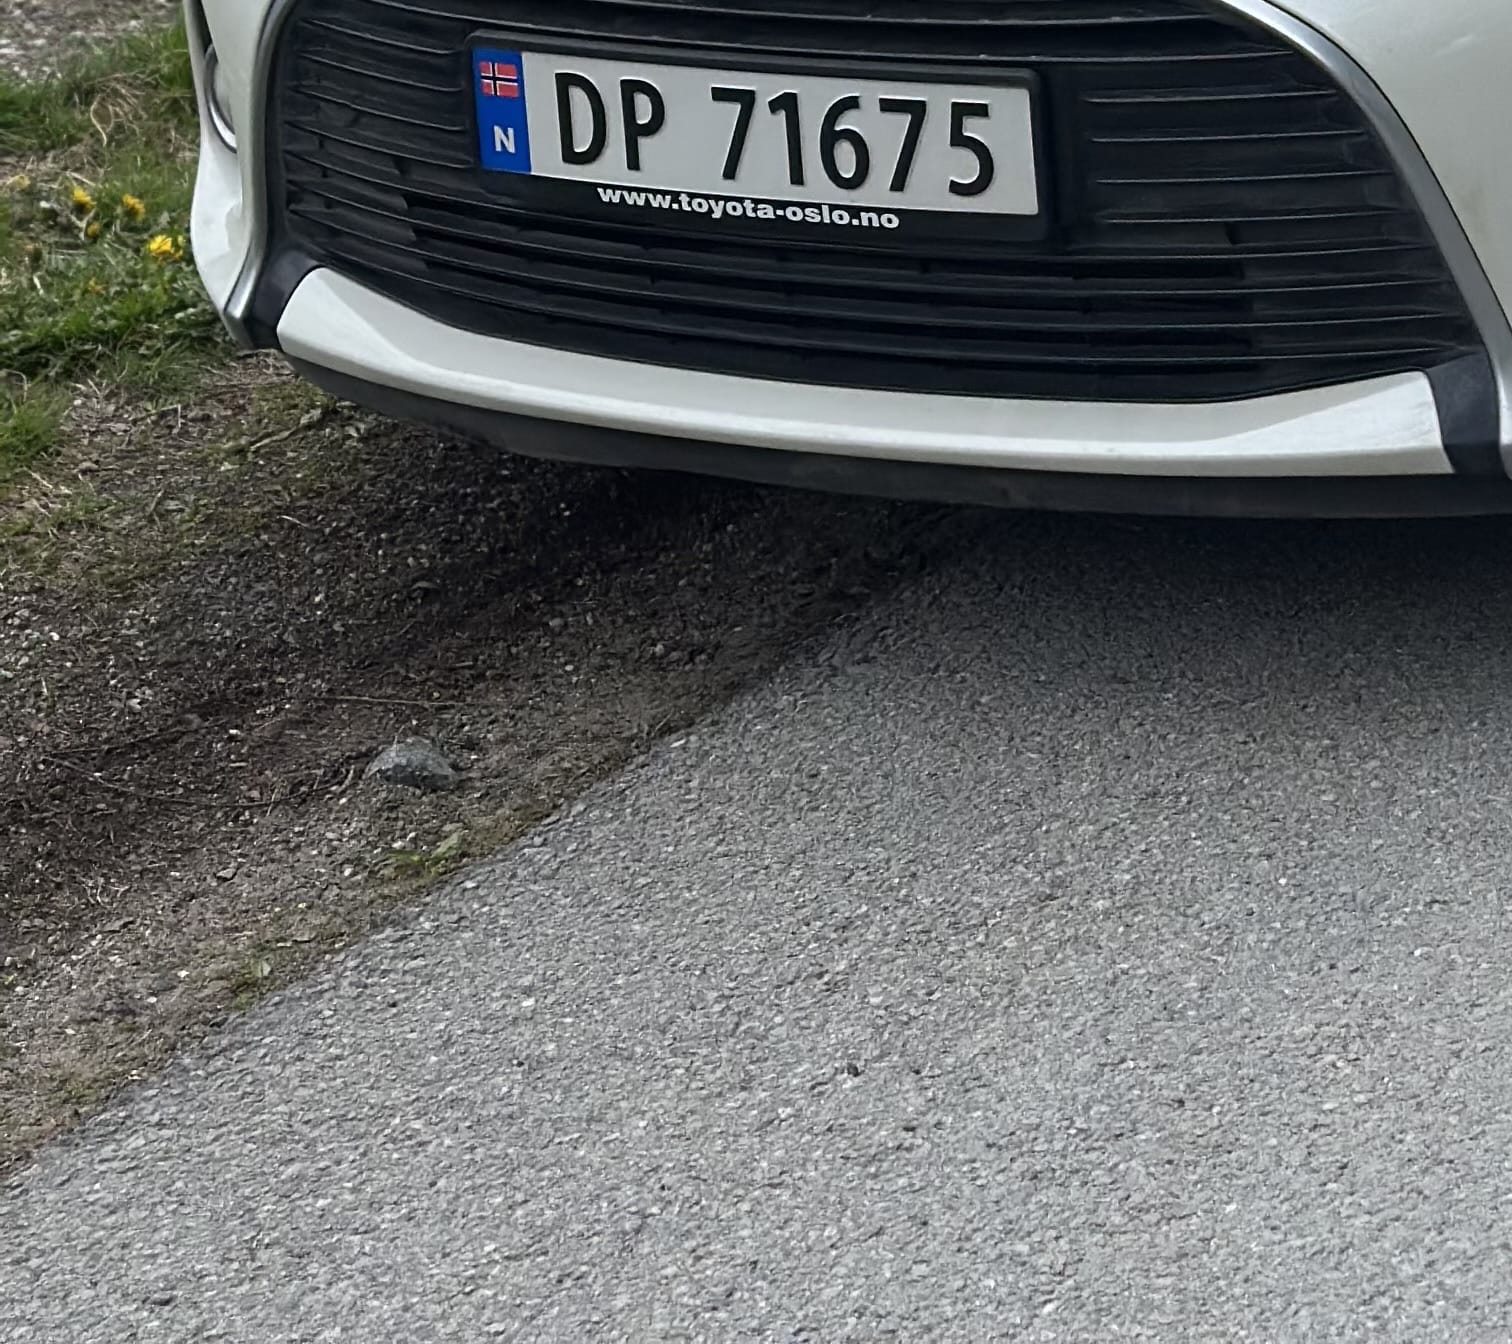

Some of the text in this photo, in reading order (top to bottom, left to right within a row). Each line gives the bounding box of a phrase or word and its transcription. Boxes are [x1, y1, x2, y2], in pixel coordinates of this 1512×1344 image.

[493, 125, 516, 154] N
[554, 71, 995, 197] DP 71675
[597, 187, 901, 230] www.toyota-oslo.no
